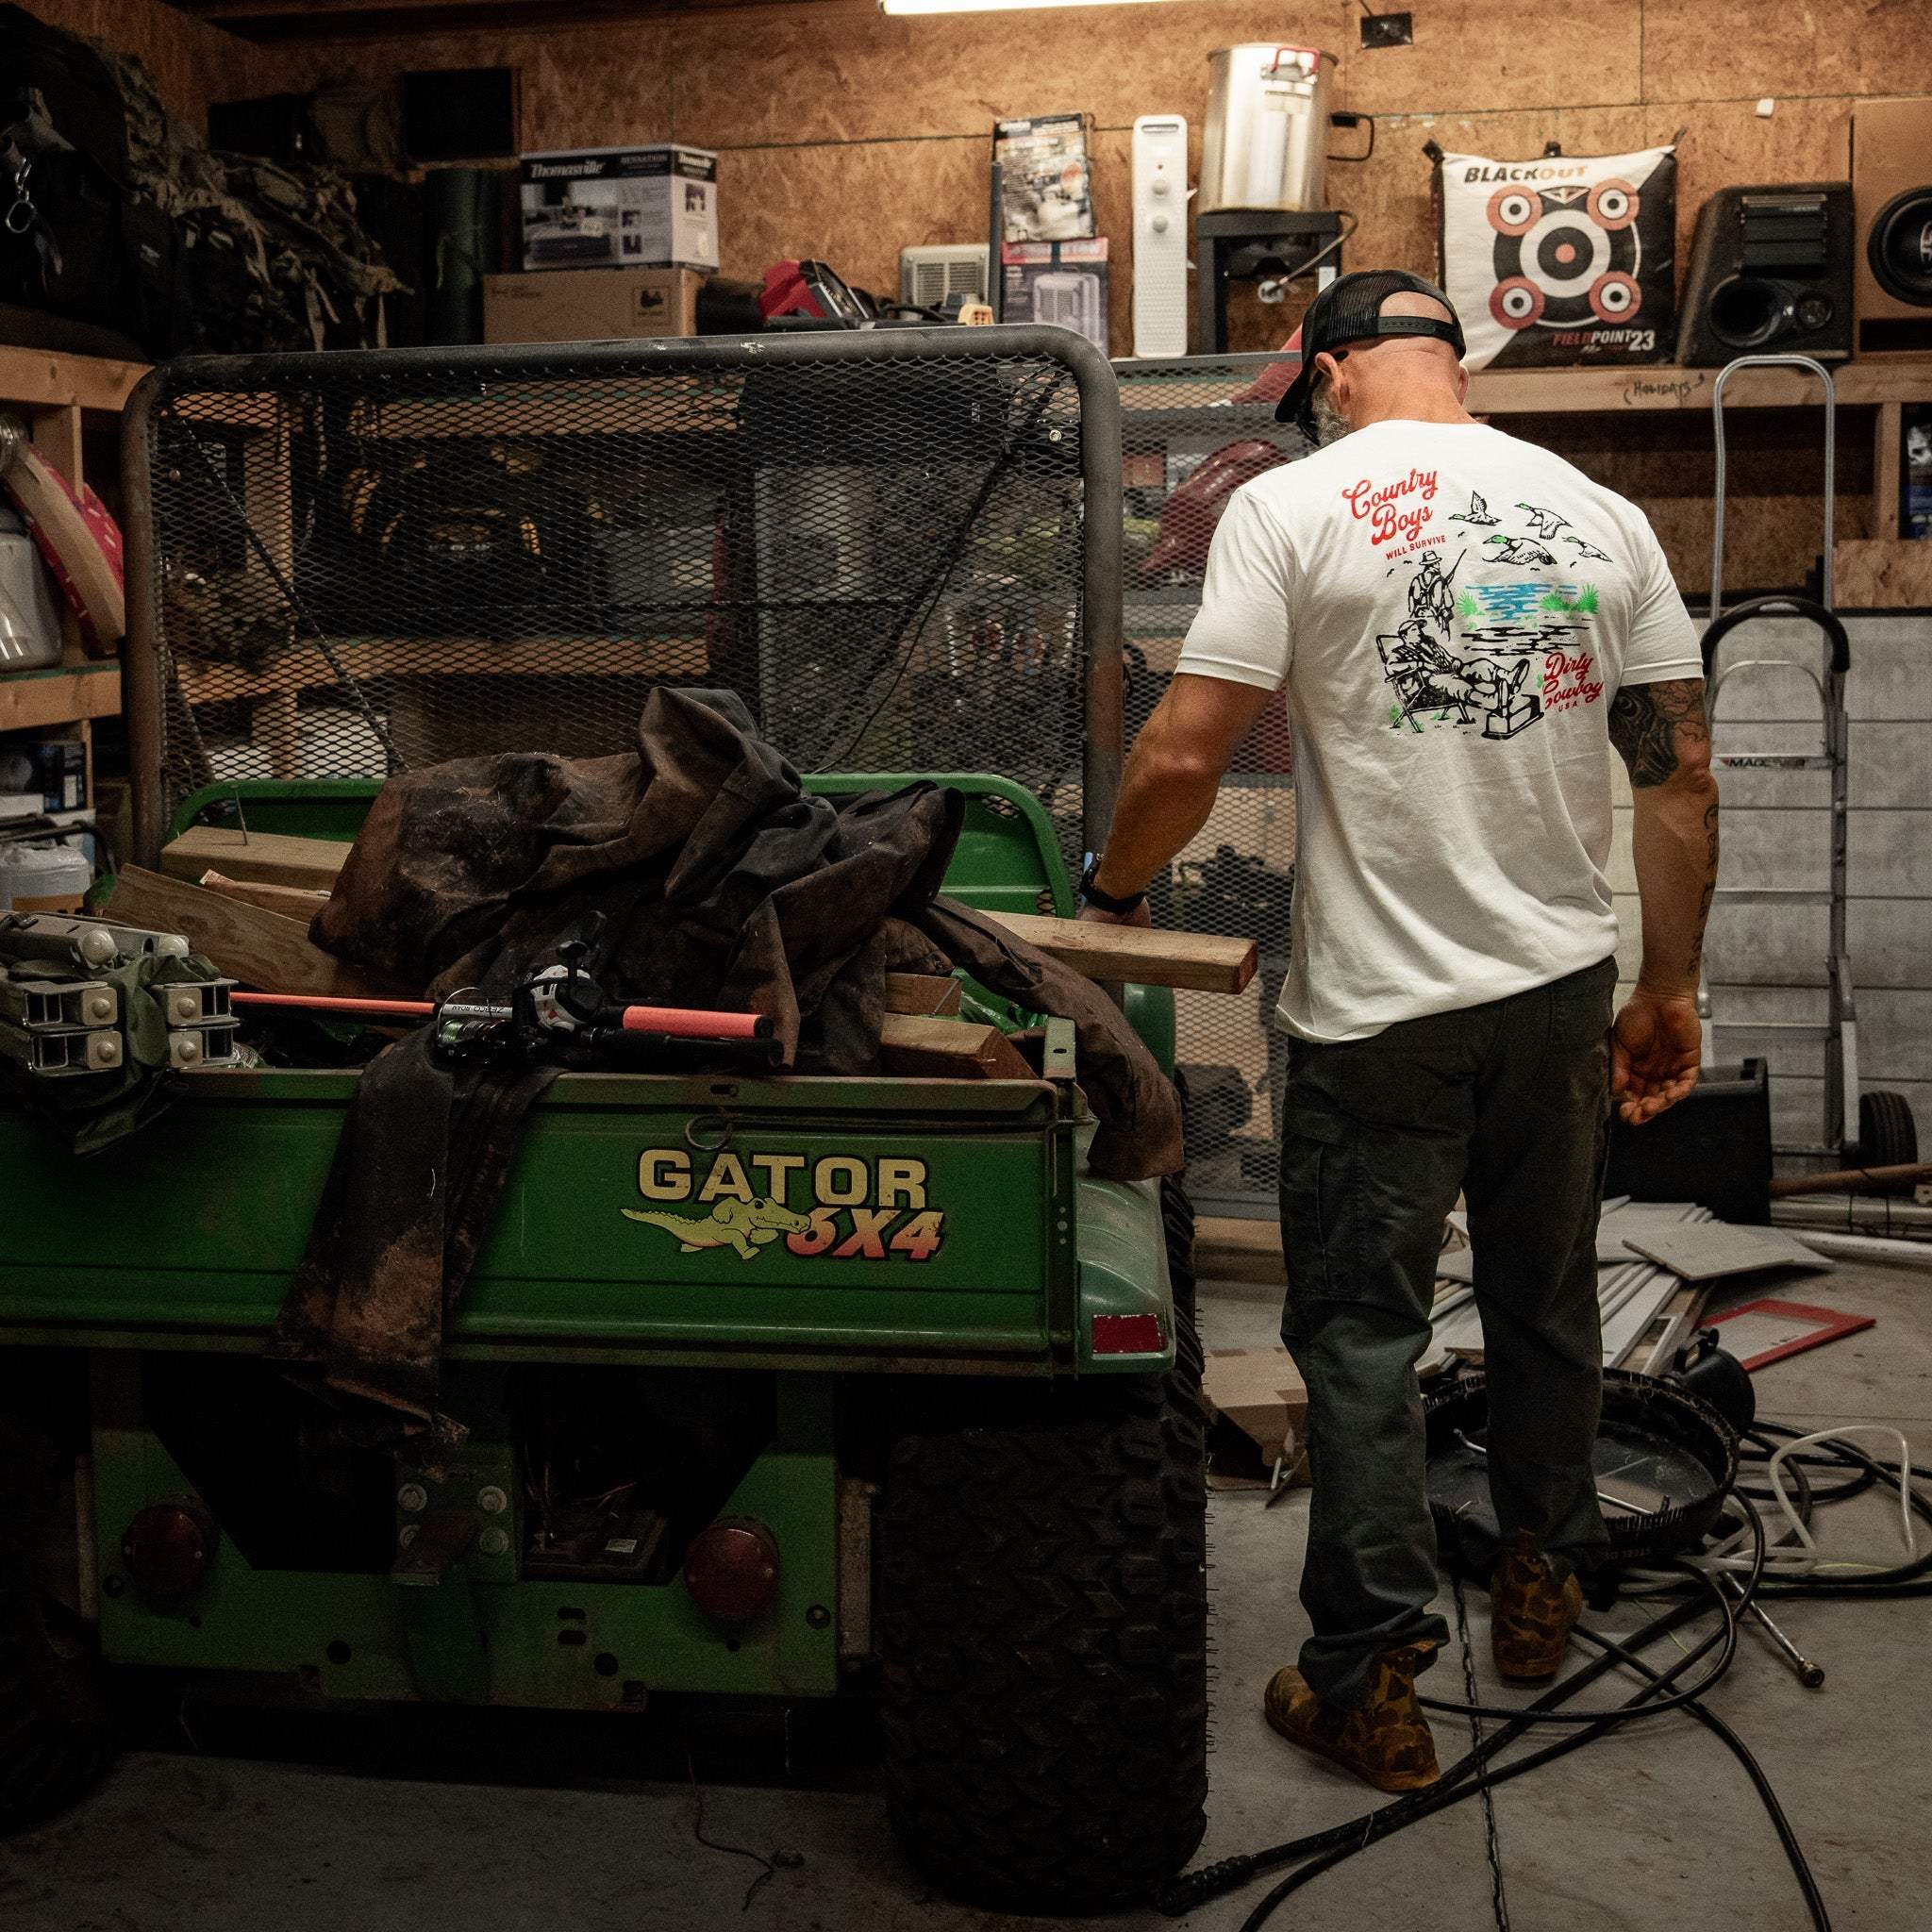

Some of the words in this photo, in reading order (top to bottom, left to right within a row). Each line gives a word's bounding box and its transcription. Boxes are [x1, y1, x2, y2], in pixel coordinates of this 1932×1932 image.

[531, 159, 606, 178] Thomasville
[1463, 166, 1588, 183] BLACKOUT
[1341, 468, 1439, 520] Country
[1371, 503, 1434, 545] Boys
[1386, 547, 1407, 560] WILL
[1409, 535, 1446, 552] SURVIVE
[1543, 652, 1594, 681] Dirty
[637, 1148, 927, 1209] GATOR
[784, 1206, 944, 1262] 6X4
